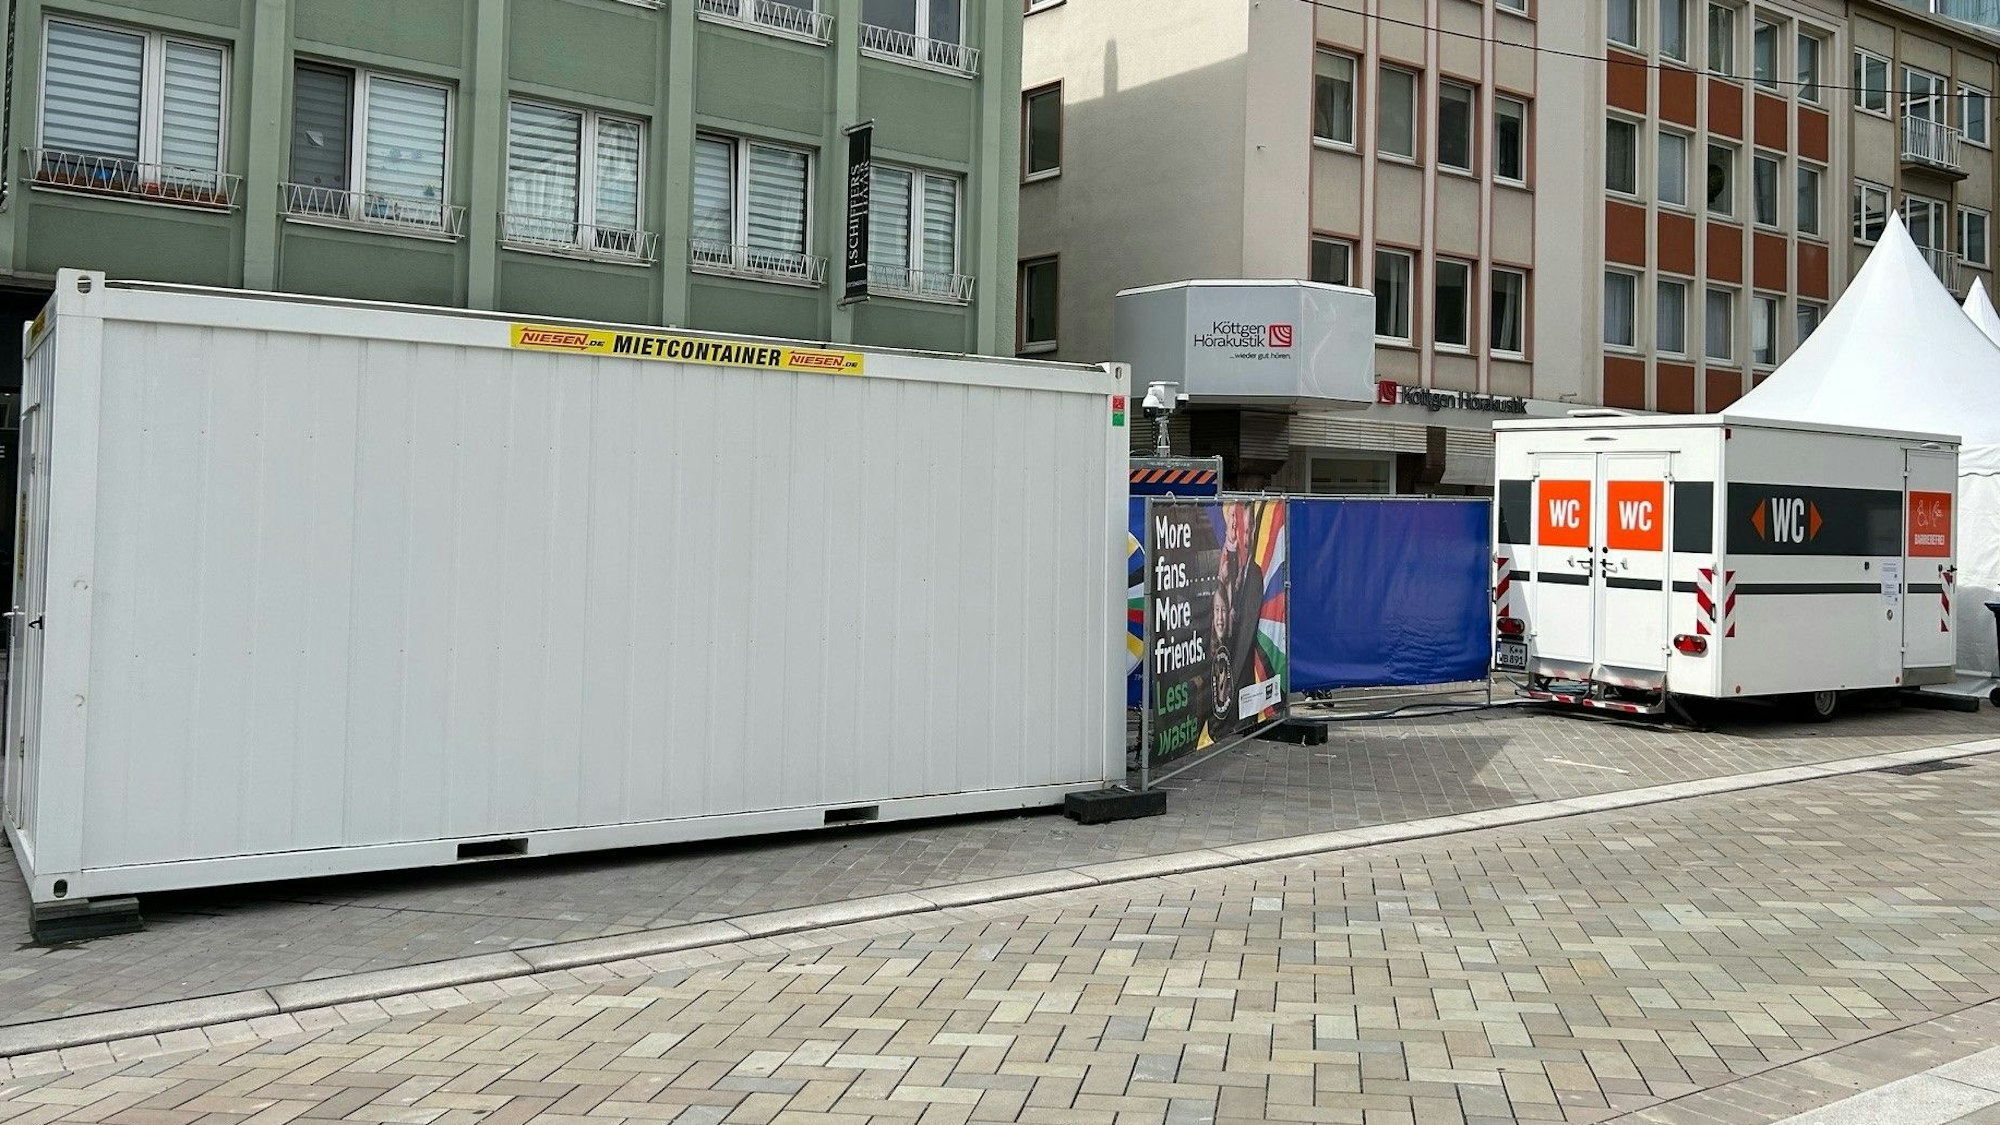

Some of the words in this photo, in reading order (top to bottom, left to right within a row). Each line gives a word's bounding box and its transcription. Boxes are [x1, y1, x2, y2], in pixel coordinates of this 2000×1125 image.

[1194, 334, 1266, 348] Hörakustik
[1213, 321, 1266, 338] Köttgen
[613, 335, 781, 366] MIETCONTAINER
[1258, 352, 1269, 361] gut
[1402, 385, 1456, 411] Köttgen
[1458, 390, 1528, 414] Hörakustik
[1549, 499, 1581, 528] WC
[1618, 500, 1653, 532] WC
[1772, 497, 1805, 544] WC
[1155, 515, 1192, 550] More
[1155, 596, 1192, 633] More
[1155, 630, 1206, 675] friends.
[1156, 681, 1189, 716] Less
[1158, 714, 1198, 756] waste
